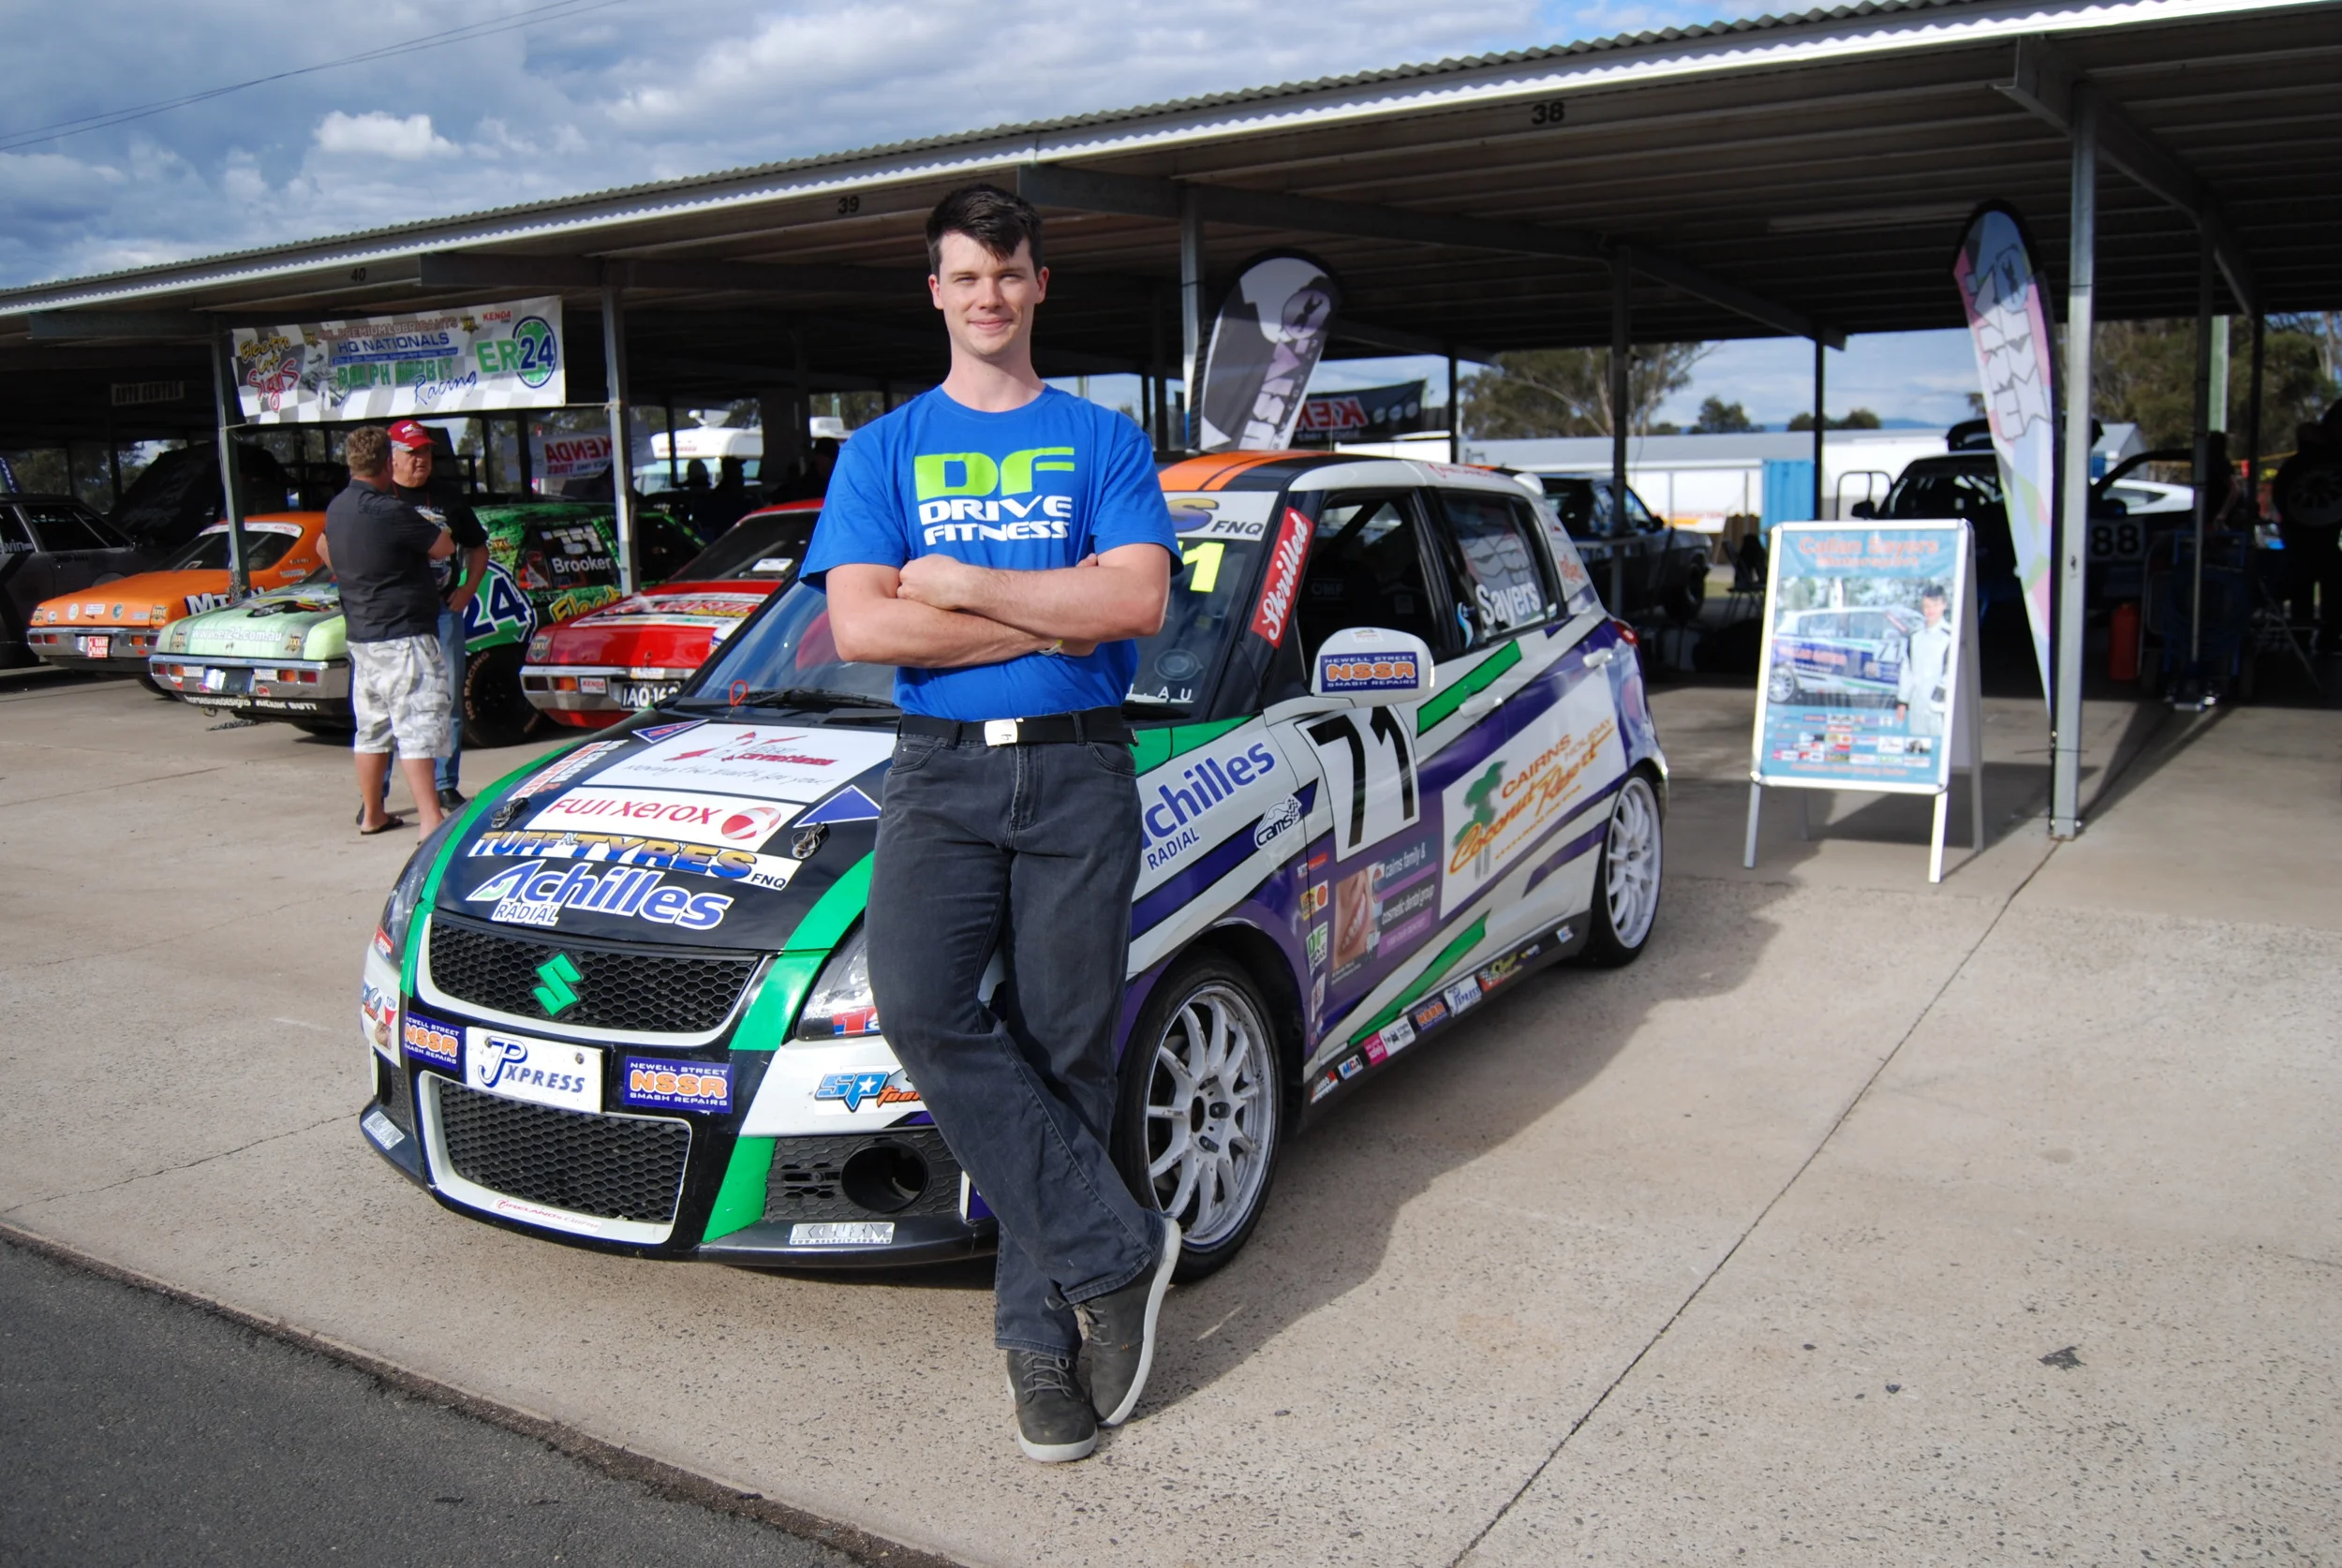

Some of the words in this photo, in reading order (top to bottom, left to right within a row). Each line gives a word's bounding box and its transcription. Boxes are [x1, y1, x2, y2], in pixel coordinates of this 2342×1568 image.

[1531, 101, 1566, 125] 38
[837, 195, 860, 214] 39
[350, 267, 366, 282] 40
[339, 325, 388, 339] PREMIUM
[388, 318, 458, 334] LUBRICANTS
[482, 310, 511, 323] KENDA
[240, 333, 291, 363] Electro
[338, 341, 360, 353] HQ
[363, 333, 450, 352] NATIONALS
[476, 334, 555, 374] ER24
[413, 370, 478, 406] Racing
[914, 447, 1075, 501] DF
[918, 496, 1072, 525] DRIVE
[924, 521, 1070, 546] FITNESS
[1211, 520, 1264, 536] FNQ
[2092, 525, 2142, 557] 88
[1868, 534, 1940, 557] Sayers
[552, 555, 611, 574] Brooker
[1177, 540, 1224, 592] 1
[1261, 511, 1310, 642] Skrilled
[1475, 582, 1543, 629] Sayers
[192, 628, 283, 643] www.er24.com.au
[1326, 660, 1416, 682] NSSR
[1305, 705, 1416, 850] 71
[1502, 734, 1571, 799] CAIRNS
[547, 797, 615, 817] FUJI
[1142, 742, 1275, 849] chilles
[473, 831, 564, 857] TUFF
[571, 834, 758, 880] TYRES
[750, 873, 788, 891] FNQ
[1147, 826, 1200, 871] RADIAL
[1386, 856, 1403, 879] cairns
[1403, 846, 1421, 867] family
[466, 859, 735, 930] Achilles
[1382, 899, 1405, 925] cosmetic
[1405, 888, 1420, 911] dental
[1419, 883, 1435, 907] group
[491, 902, 560, 926] RADIAL
[386, 996, 397, 1010] TOW
[406, 1014, 430, 1029] NEWELL
[431, 1019, 460, 1037] STREET
[404, 1022, 459, 1058] NSSR
[404, 1043, 425, 1056] SMASH
[425, 1049, 458, 1065] REPAIRS
[504, 1065, 586, 1094] XPRESS
[630, 1062, 676, 1072] NEWELL
[681, 1066, 728, 1076] STREET
[630, 1070, 729, 1098] NSSR
[814, 1072, 890, 1114] SP
[630, 1091, 672, 1102] SMASH
[674, 1096, 728, 1107] REPAIRS
